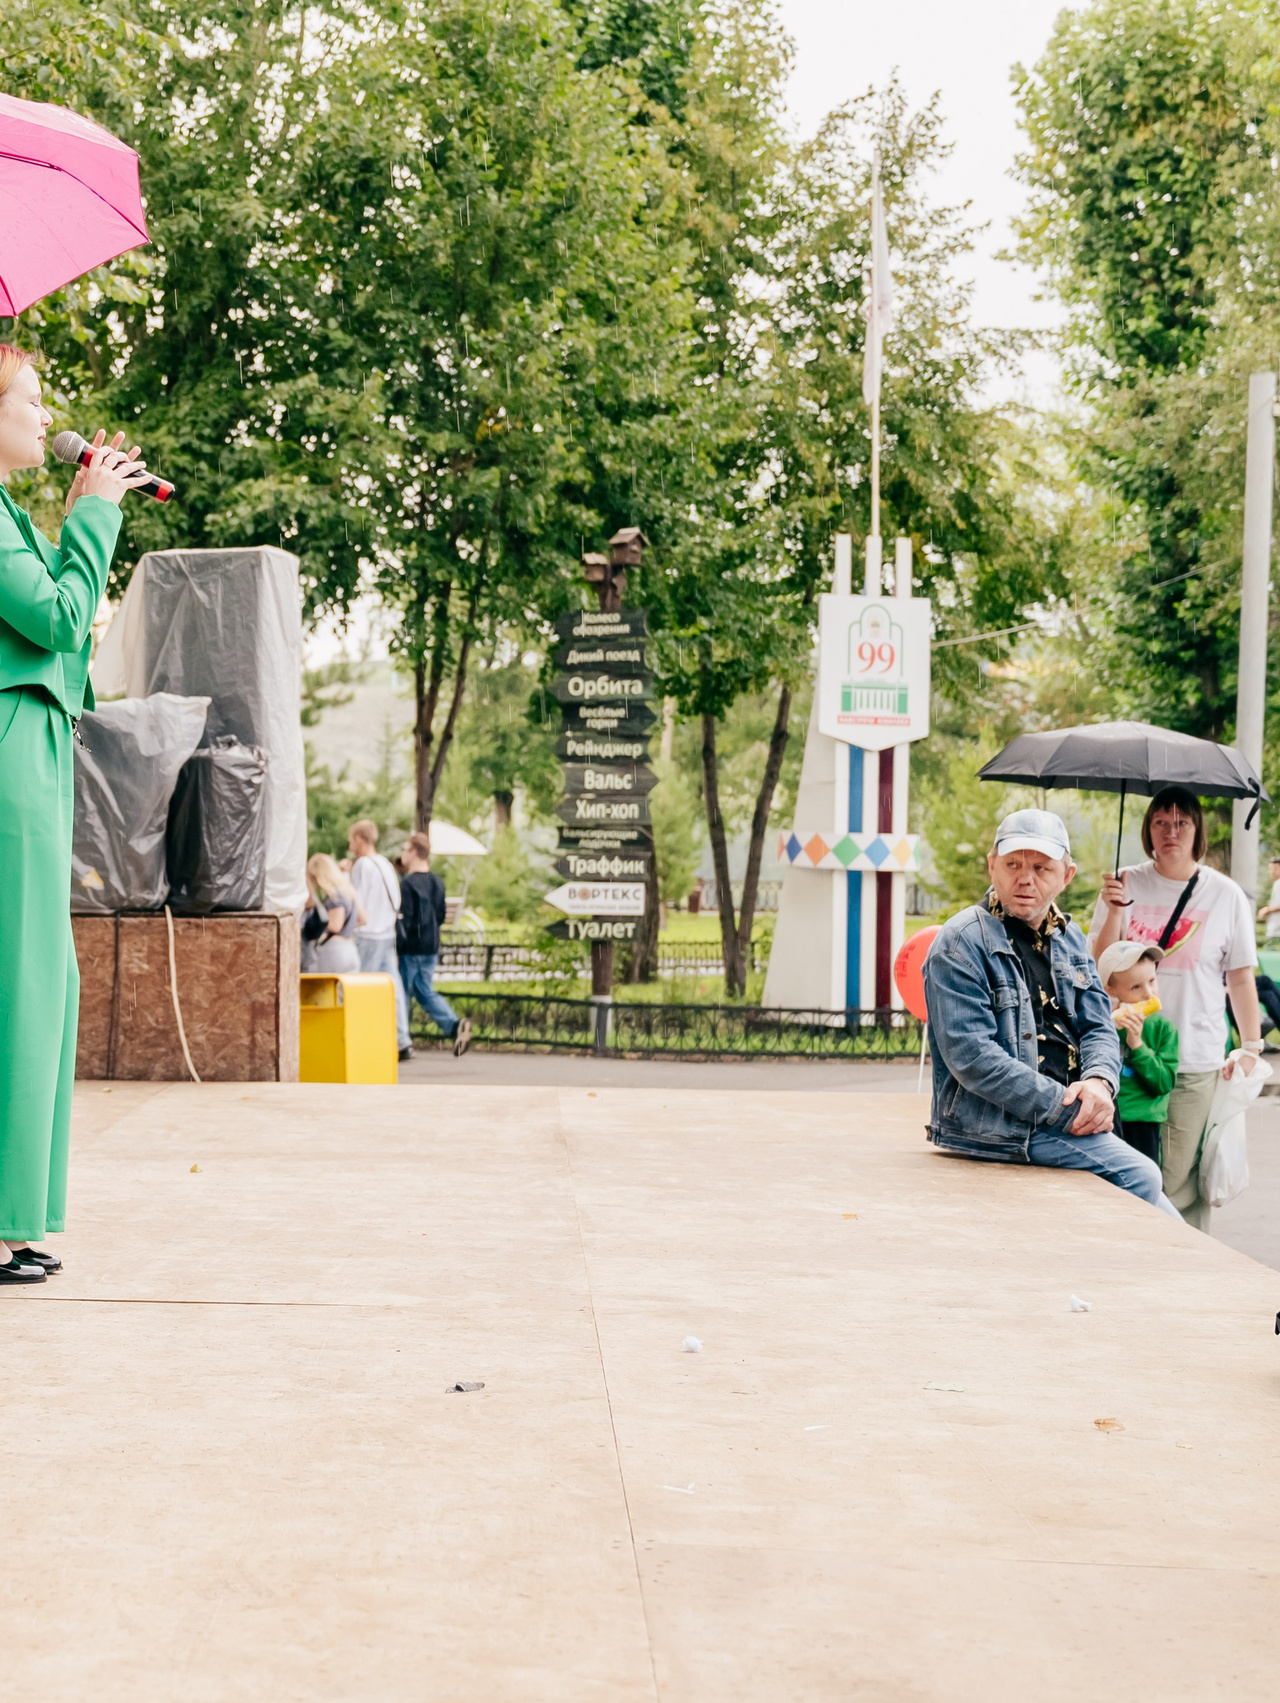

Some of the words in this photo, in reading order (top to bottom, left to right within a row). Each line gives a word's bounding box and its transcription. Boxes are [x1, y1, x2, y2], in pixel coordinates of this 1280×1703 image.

[582, 612, 621, 624] Колесо
[566, 649, 604, 664] Дикий
[606, 650, 641, 663] поезд
[858, 641, 895, 674] 99
[568, 674, 643, 699] Орбита
[566, 740, 643, 759] Рейнджер
[584, 769, 633, 790] Вальс
[576, 799, 639, 819] Хип-хоп
[566, 855, 645, 877] Траффик
[565, 920, 636, 940] Туалет
